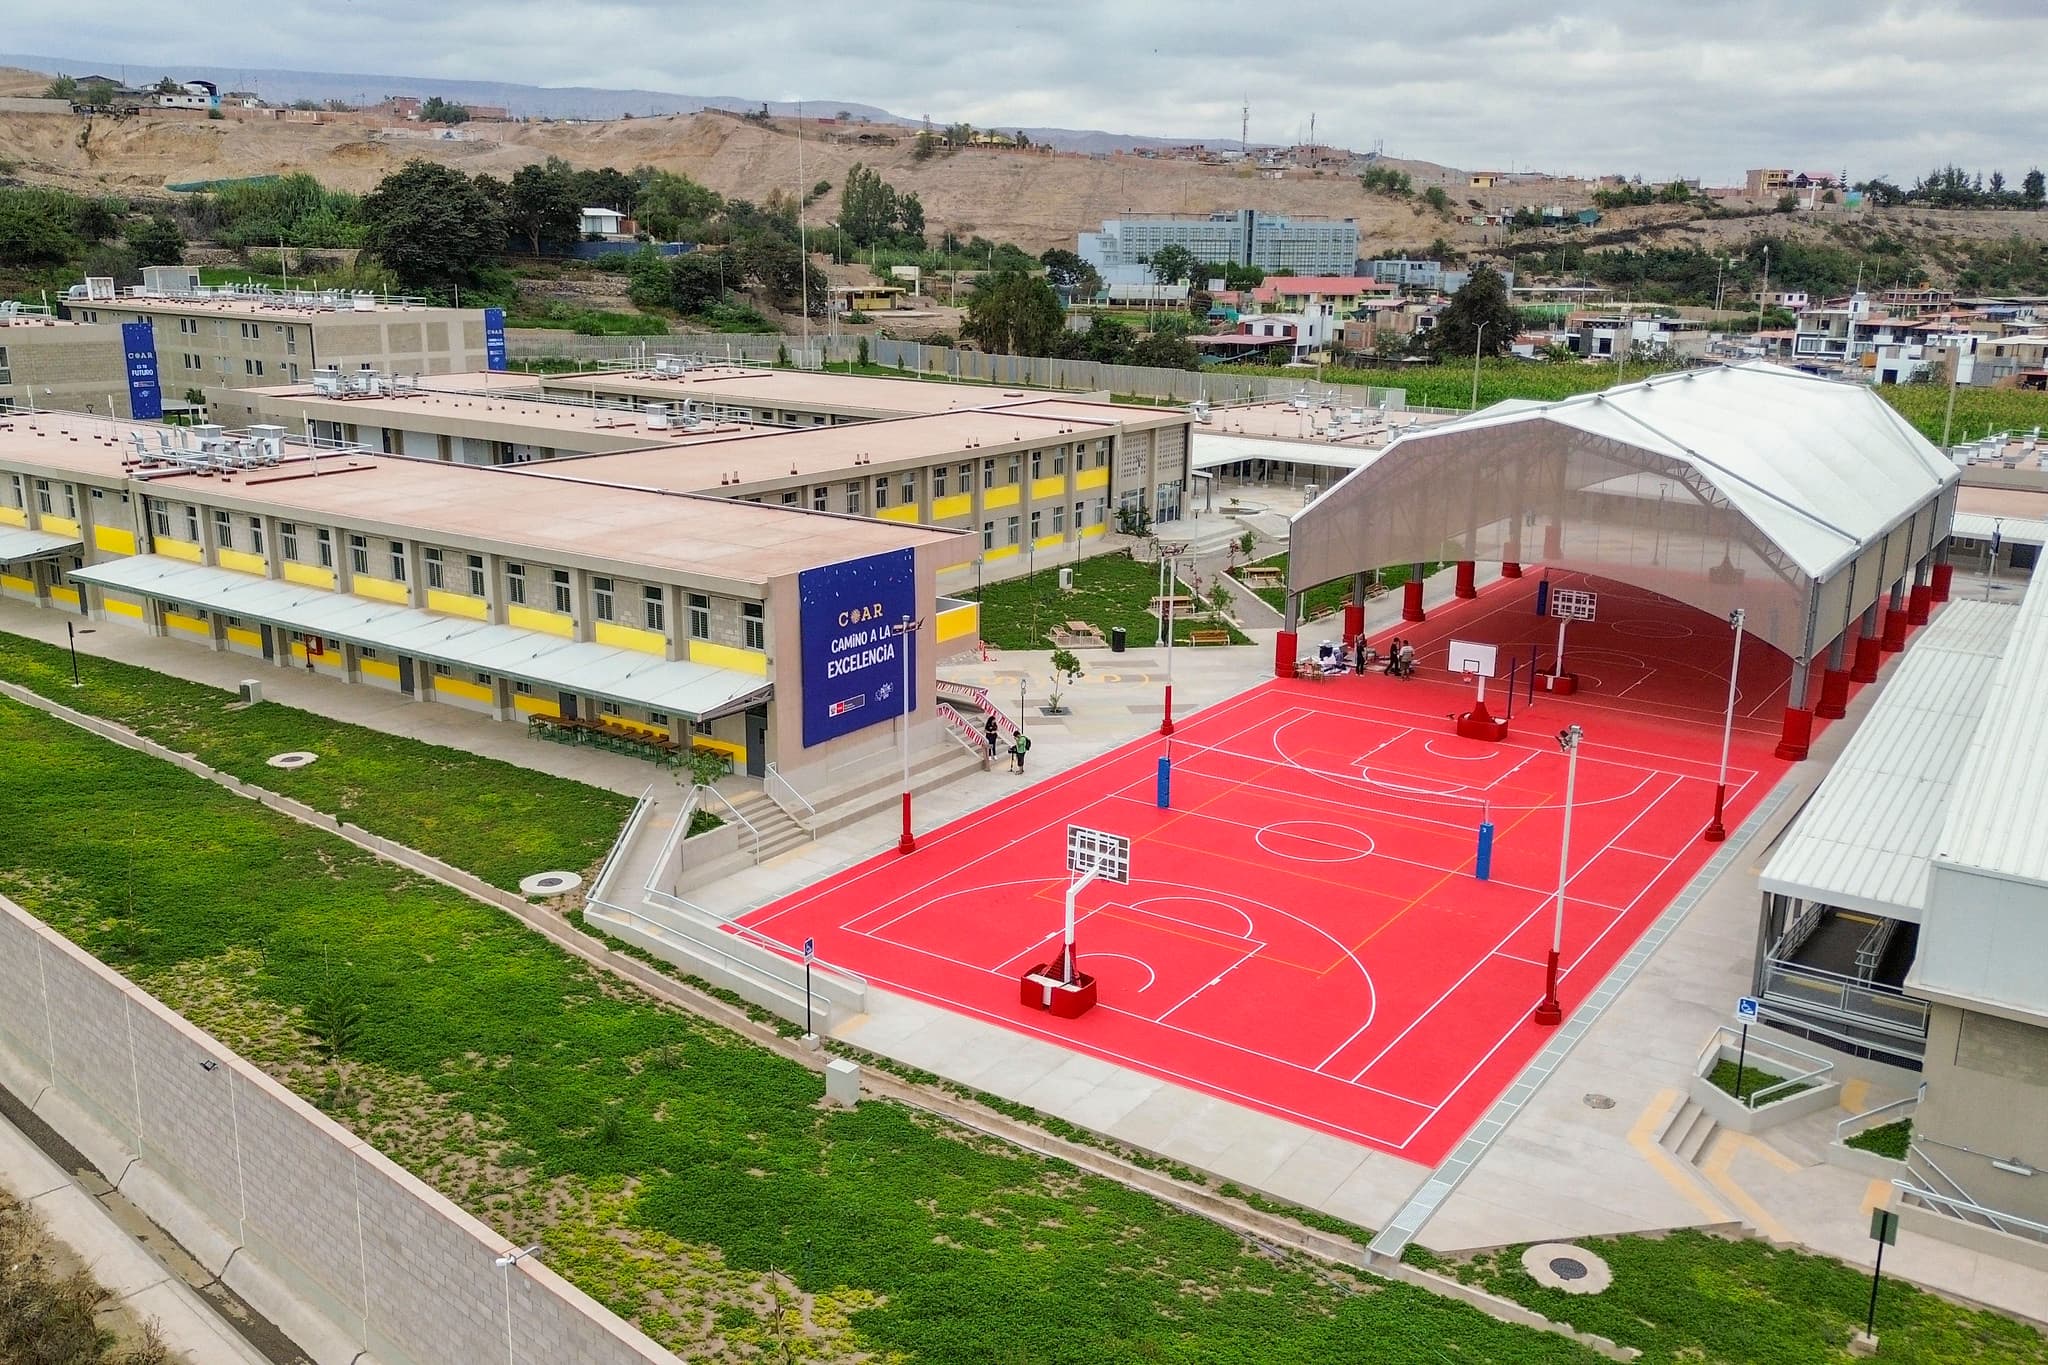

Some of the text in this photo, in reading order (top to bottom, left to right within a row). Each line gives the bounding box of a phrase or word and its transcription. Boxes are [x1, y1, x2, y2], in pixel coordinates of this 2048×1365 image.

[838, 603, 883, 627] COAR
[870, 628, 877, 643] A
[879, 624, 891, 640] LA
